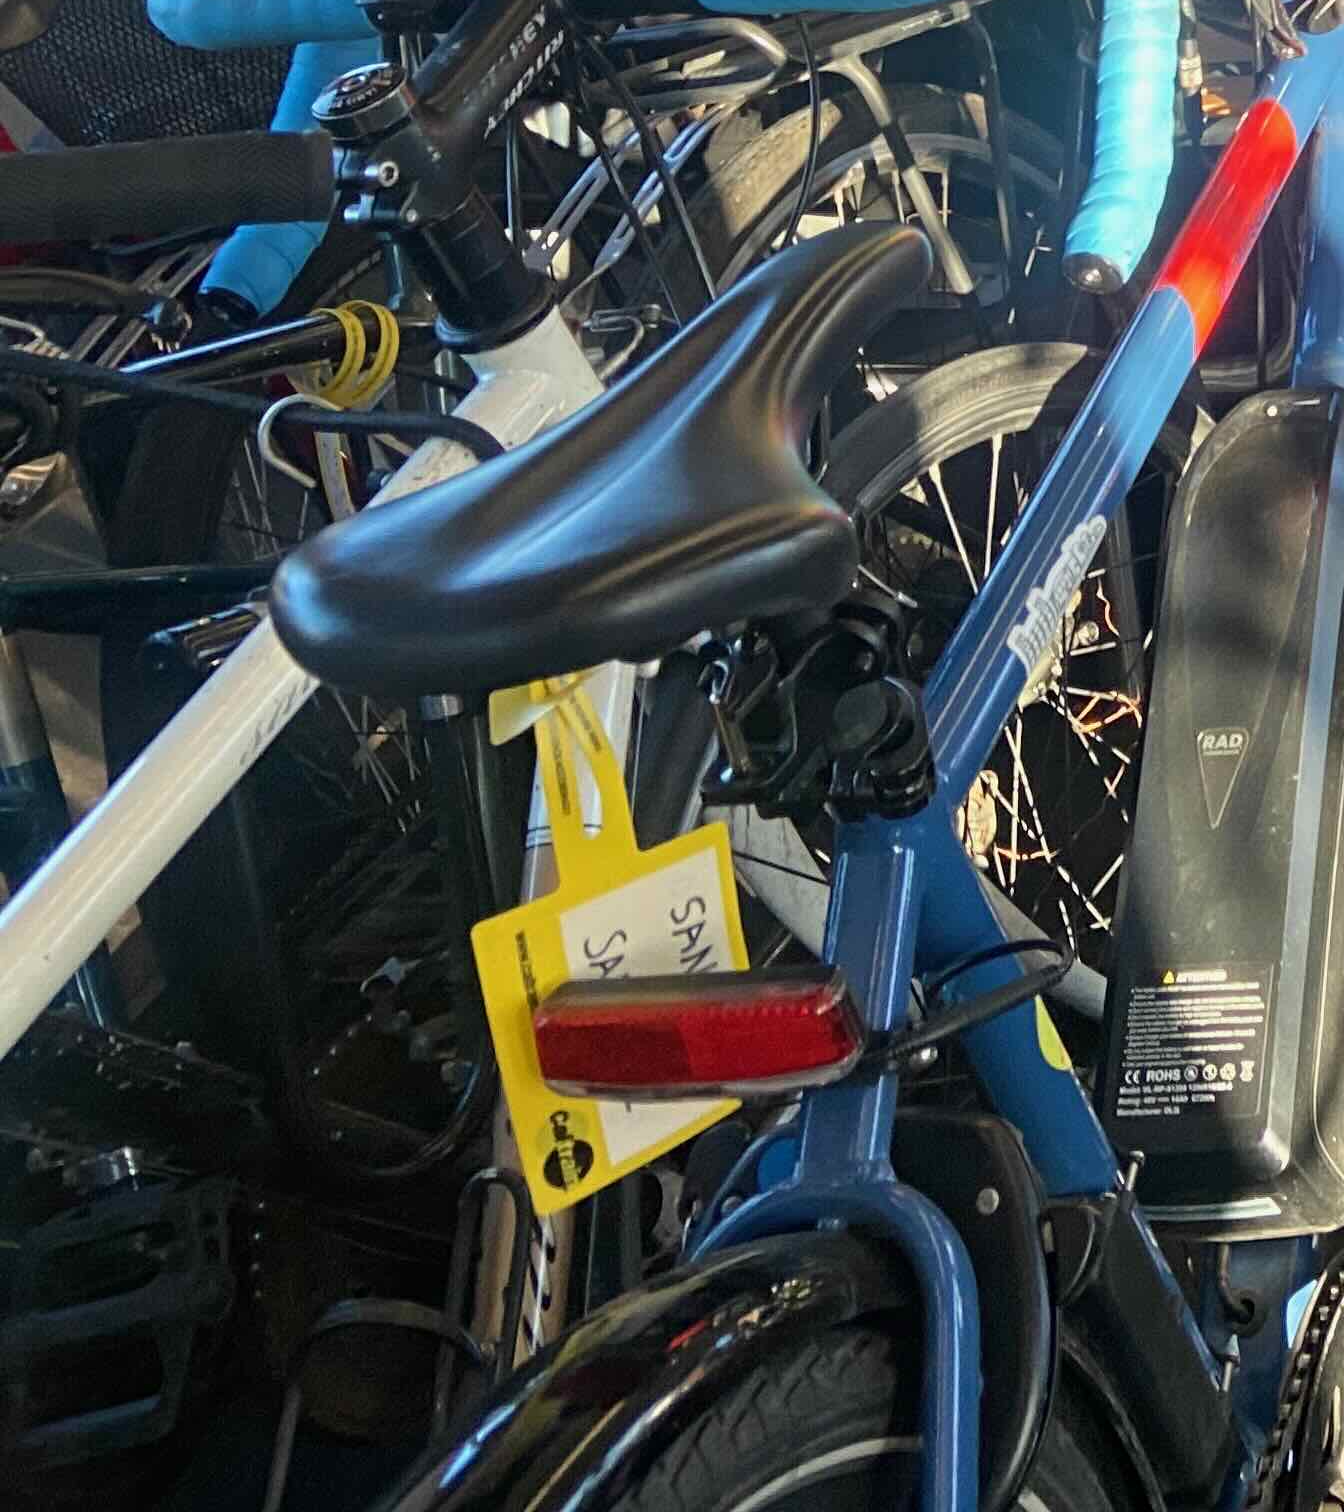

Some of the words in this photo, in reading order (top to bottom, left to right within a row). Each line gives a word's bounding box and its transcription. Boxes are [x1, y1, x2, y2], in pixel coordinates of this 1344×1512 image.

[1202, 733, 1243, 749] RAD
[583, 928, 629, 979] SA
[1145, 1067, 1181, 1083] ROHS
[549, 1110, 582, 1189] Caltrain
